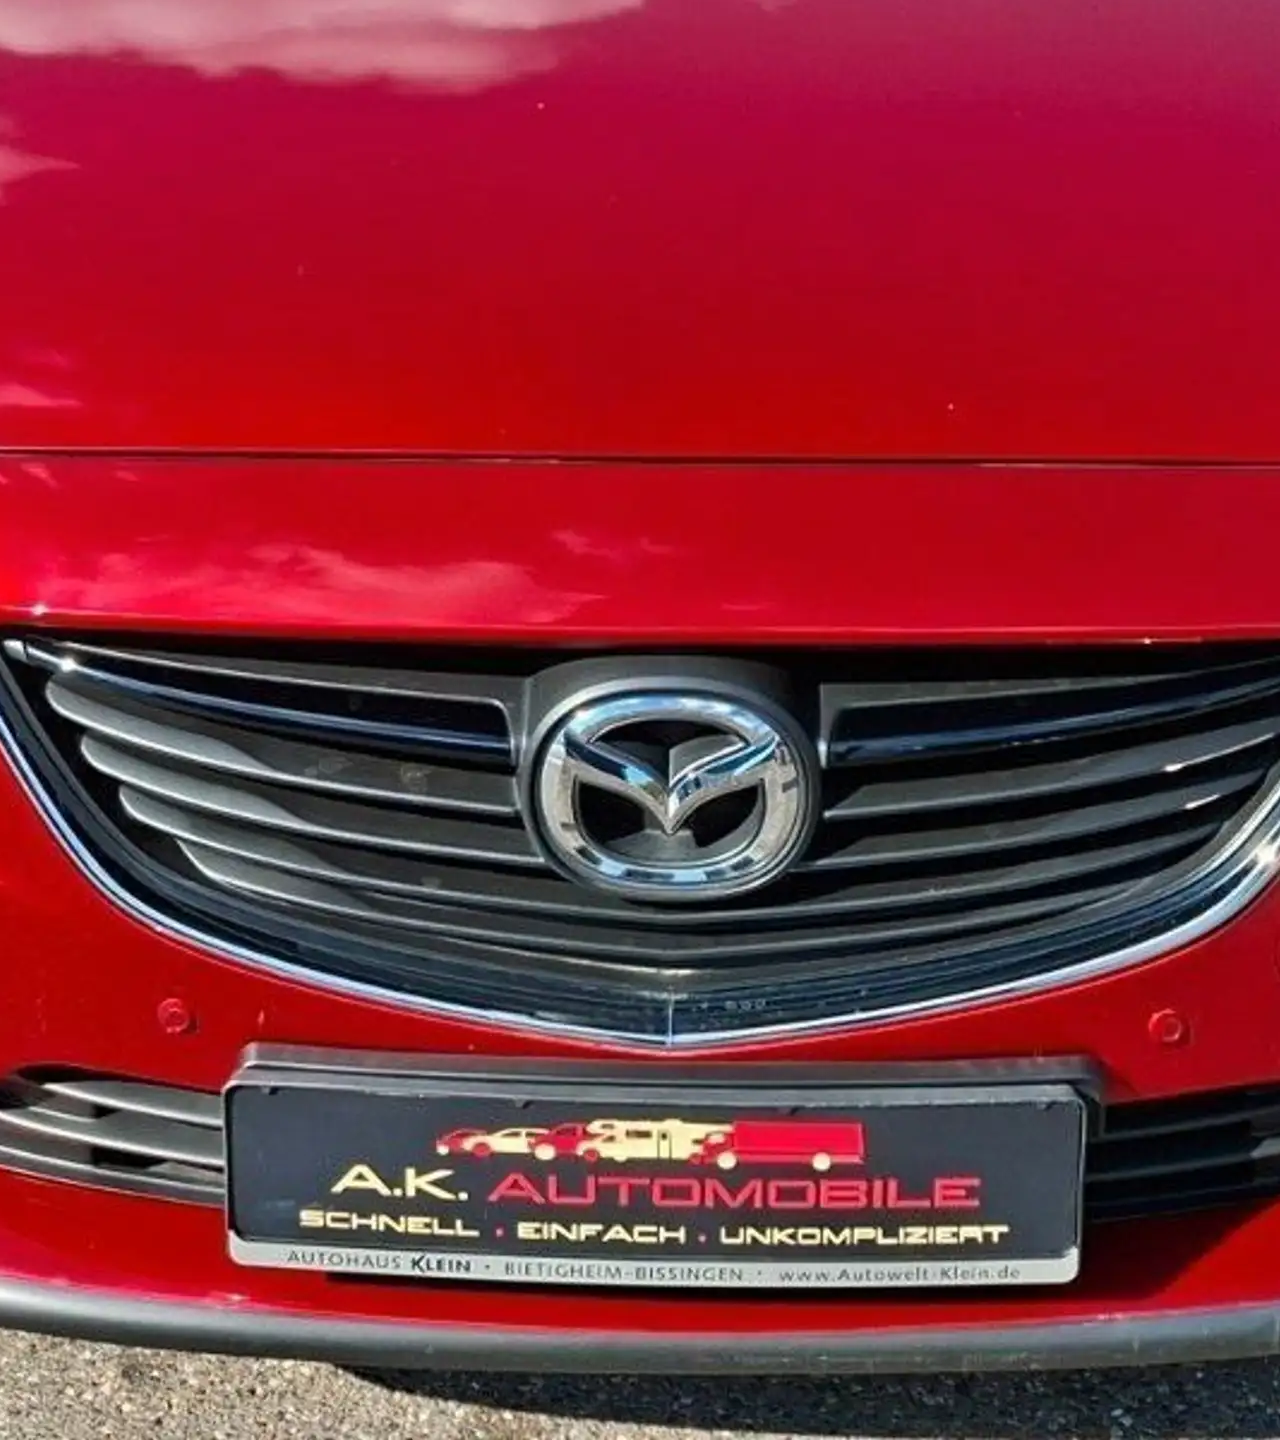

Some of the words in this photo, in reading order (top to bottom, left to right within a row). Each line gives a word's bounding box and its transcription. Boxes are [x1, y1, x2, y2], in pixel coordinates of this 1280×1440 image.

[330, 1163, 469, 1201] A.K.
[487, 1172, 981, 1210] AUTOMOBILE
[299, 1209, 480, 1238] SCHNELL
[517, 1221, 687, 1244] EINFACH
[721, 1224, 1010, 1246] UNKOMPLIZIERT
[286, 1250, 402, 1271] AUTOHAUS
[410, 1253, 472, 1274] KLEIN
[504, 1260, 743, 1283] BIETIGHEIM-BISSINGEN
[779, 1266, 1021, 1283] www.Autowelt-Klein.de
